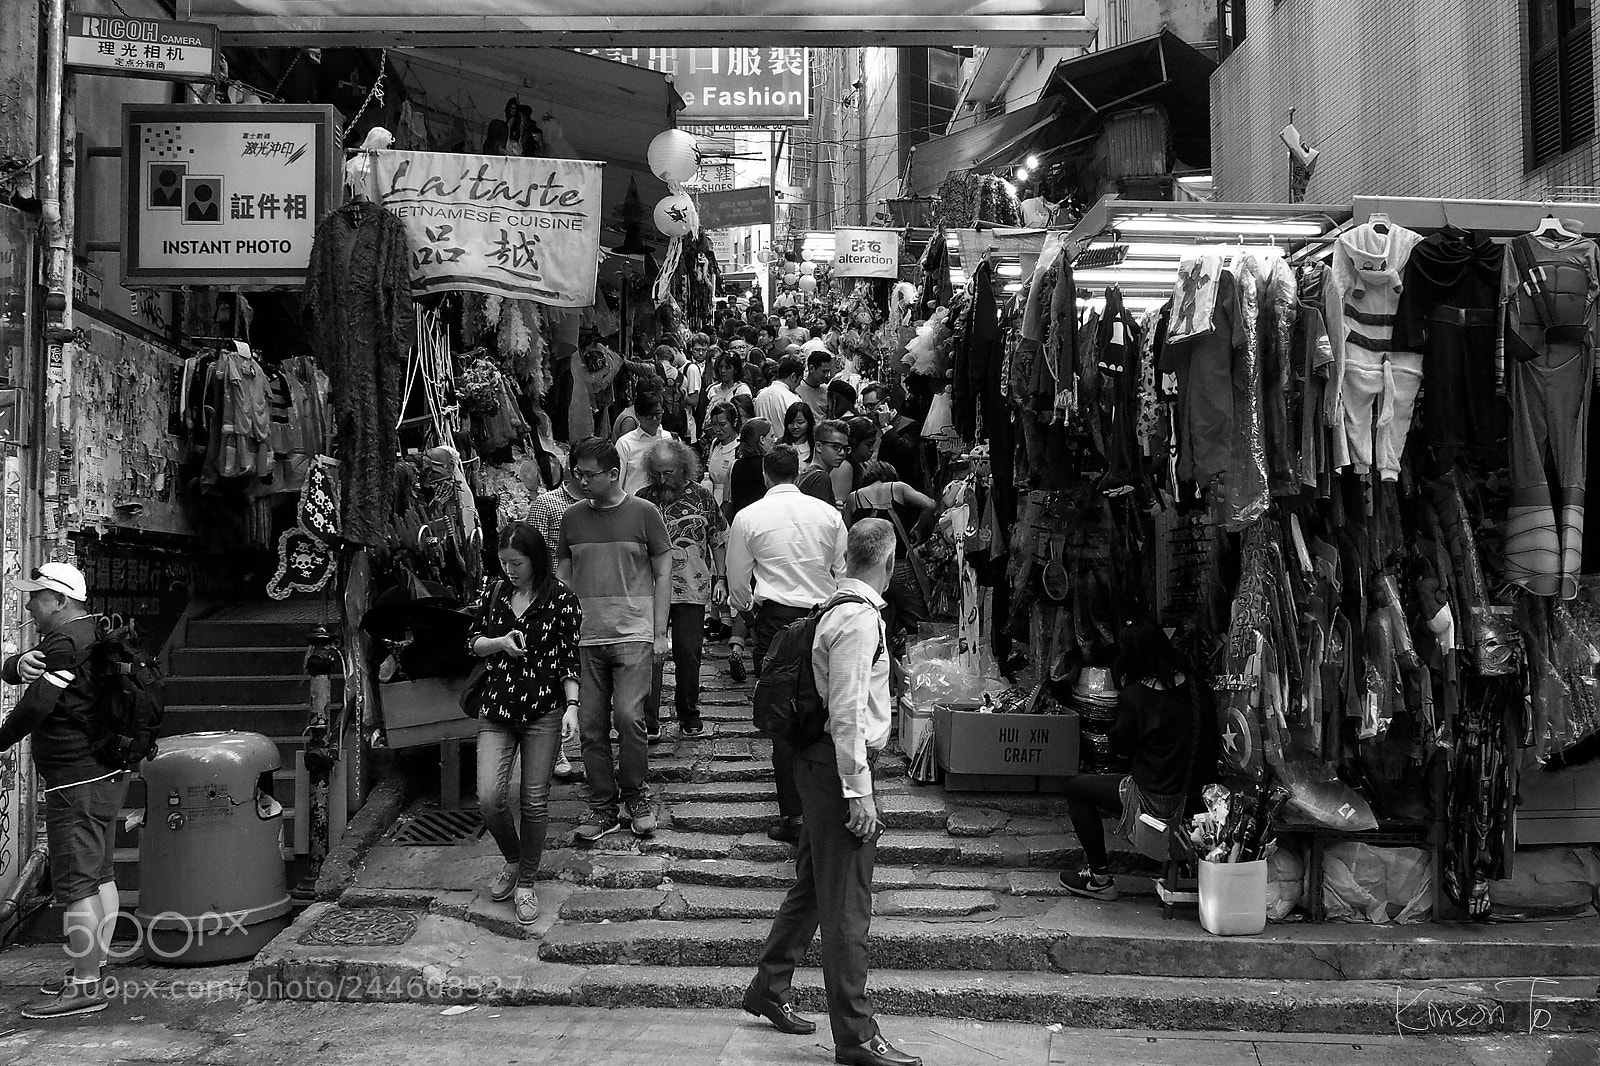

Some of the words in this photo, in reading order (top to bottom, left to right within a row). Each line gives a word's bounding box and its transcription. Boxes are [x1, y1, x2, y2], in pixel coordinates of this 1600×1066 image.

[82, 17, 159, 41] RICOH
[161, 35, 202, 46] CAMERA
[98, 41, 184, 61] 理光相机
[703, 86, 802, 106] Fashion
[230, 192, 307, 220] 証件相
[507, 215, 584, 231] CUISINE
[163, 240, 232, 254] INSTANT
[236, 240, 292, 254] PHOTO
[839, 253, 893, 265] alteration
[1000, 727, 1019, 743] HUI
[1029, 728, 1049, 744] XIN
[1004, 747, 1044, 763] CRAFT
